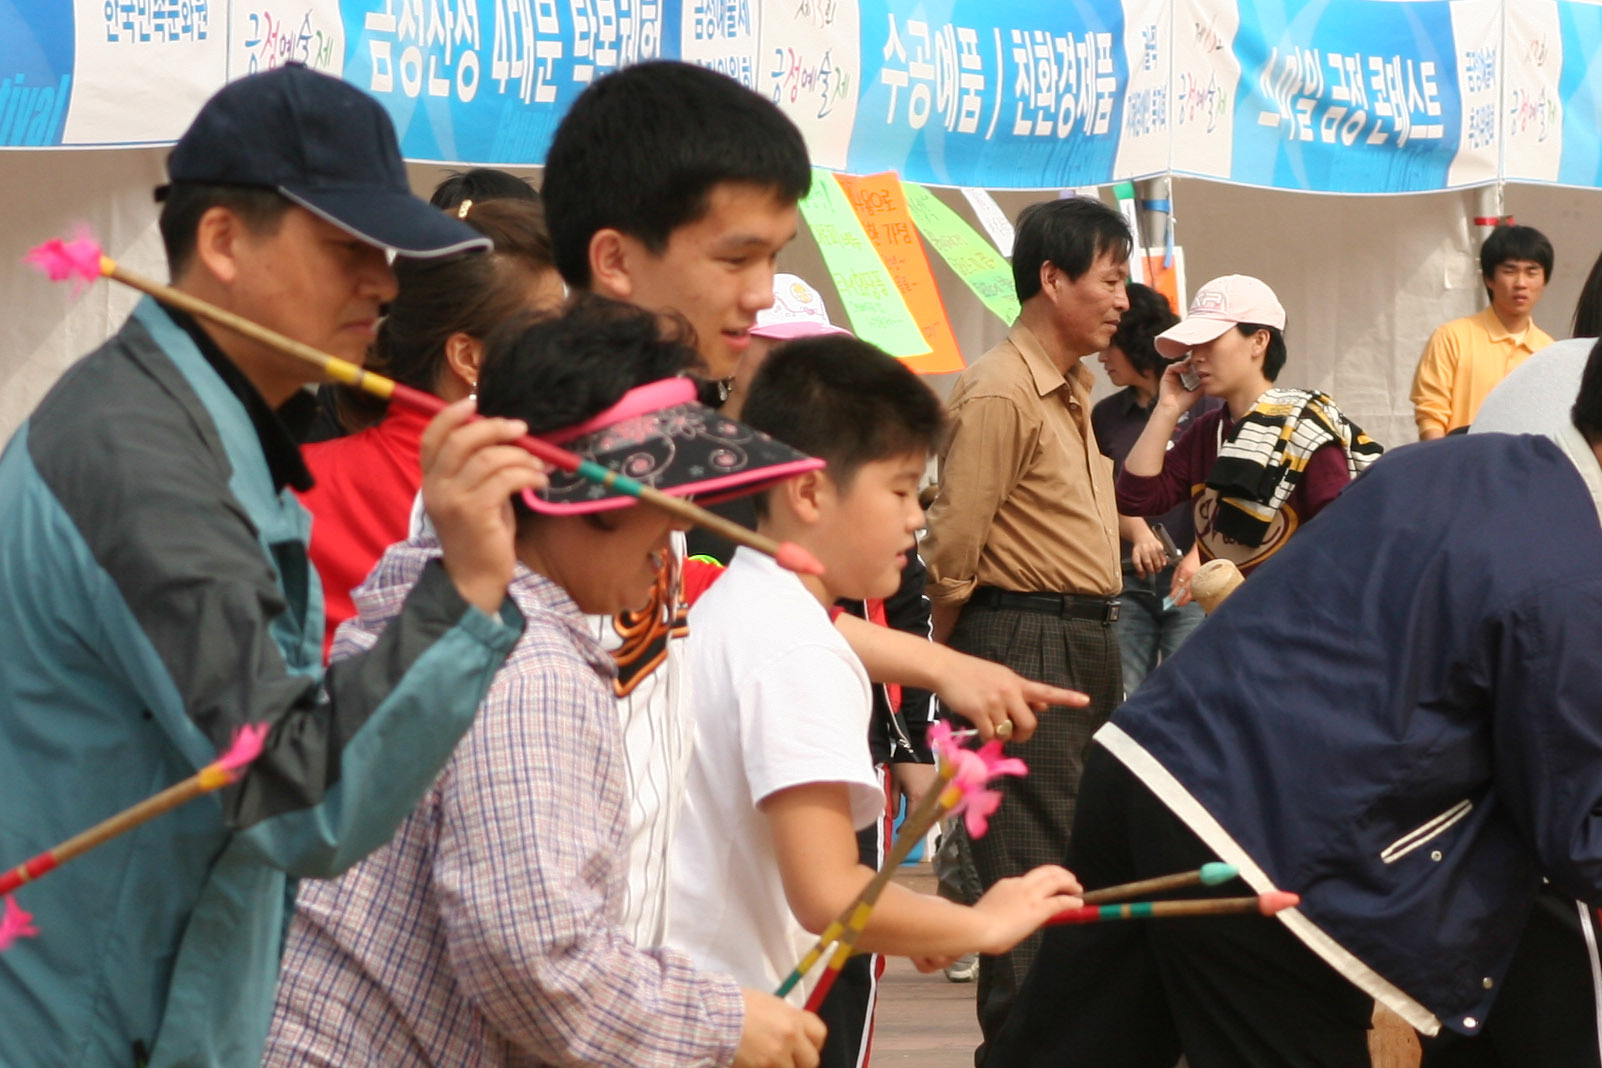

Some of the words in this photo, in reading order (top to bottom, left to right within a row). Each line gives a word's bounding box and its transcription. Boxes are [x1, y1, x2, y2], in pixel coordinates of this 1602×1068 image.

[365, 0, 480, 103] 금정산성
[491, 0, 563, 105] 4대문
[881, 13, 985, 134] 수공예품
[1011, 29, 1118, 139] 친환경제품
[1257, 46, 1325, 141] 스마일
[1327, 52, 1369, 146] 금정
[1365, 54, 1444, 148] 콘테스트
